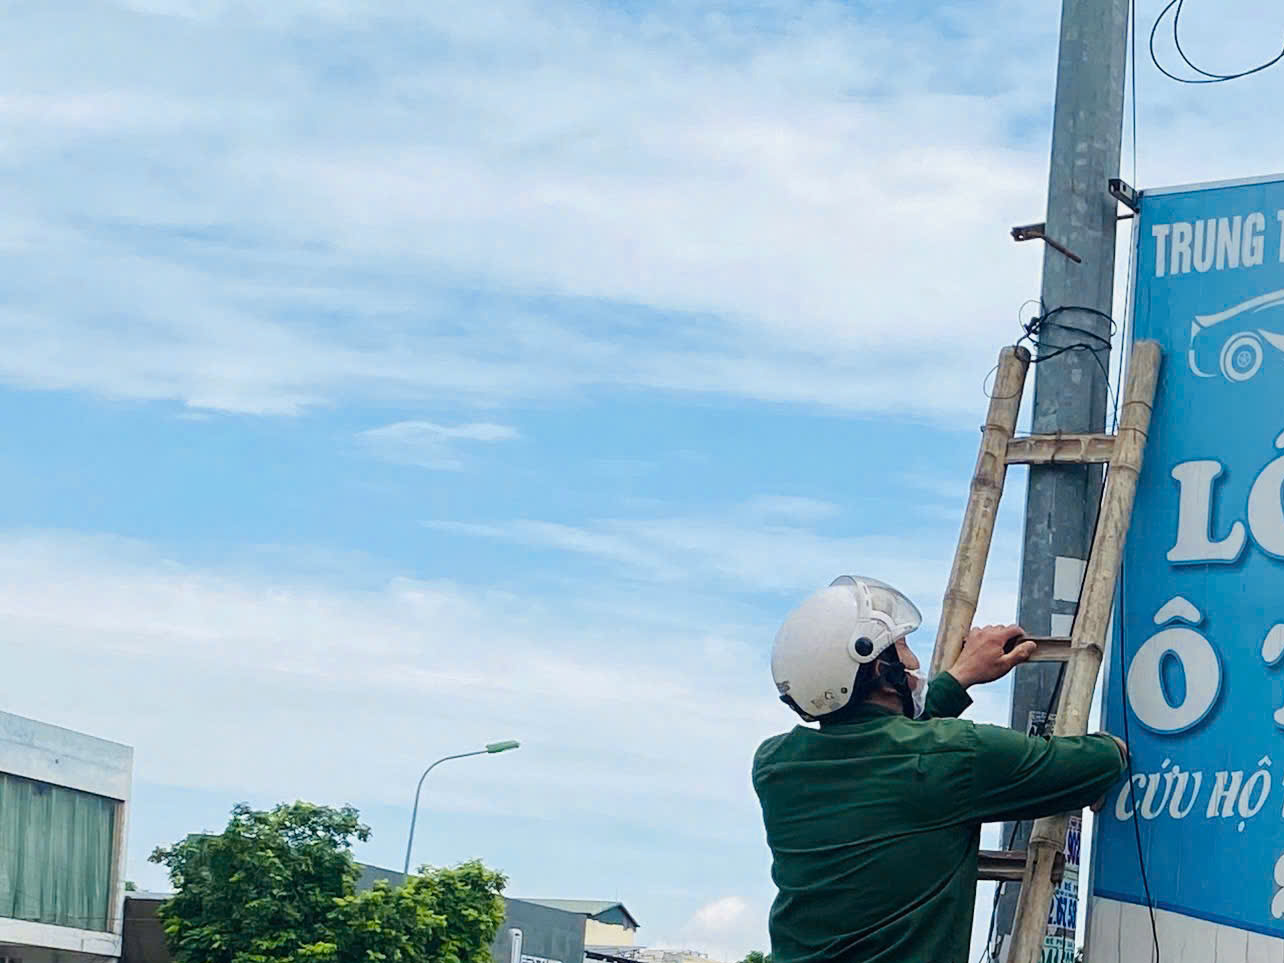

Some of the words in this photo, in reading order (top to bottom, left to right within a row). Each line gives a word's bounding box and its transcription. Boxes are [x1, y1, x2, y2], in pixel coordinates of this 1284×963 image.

[1152, 211, 1264, 278] TRUNG
[1127, 594, 1223, 734] Ô
[1114, 757, 1202, 821] CỨU
[1206, 756, 1272, 833] HỘ
